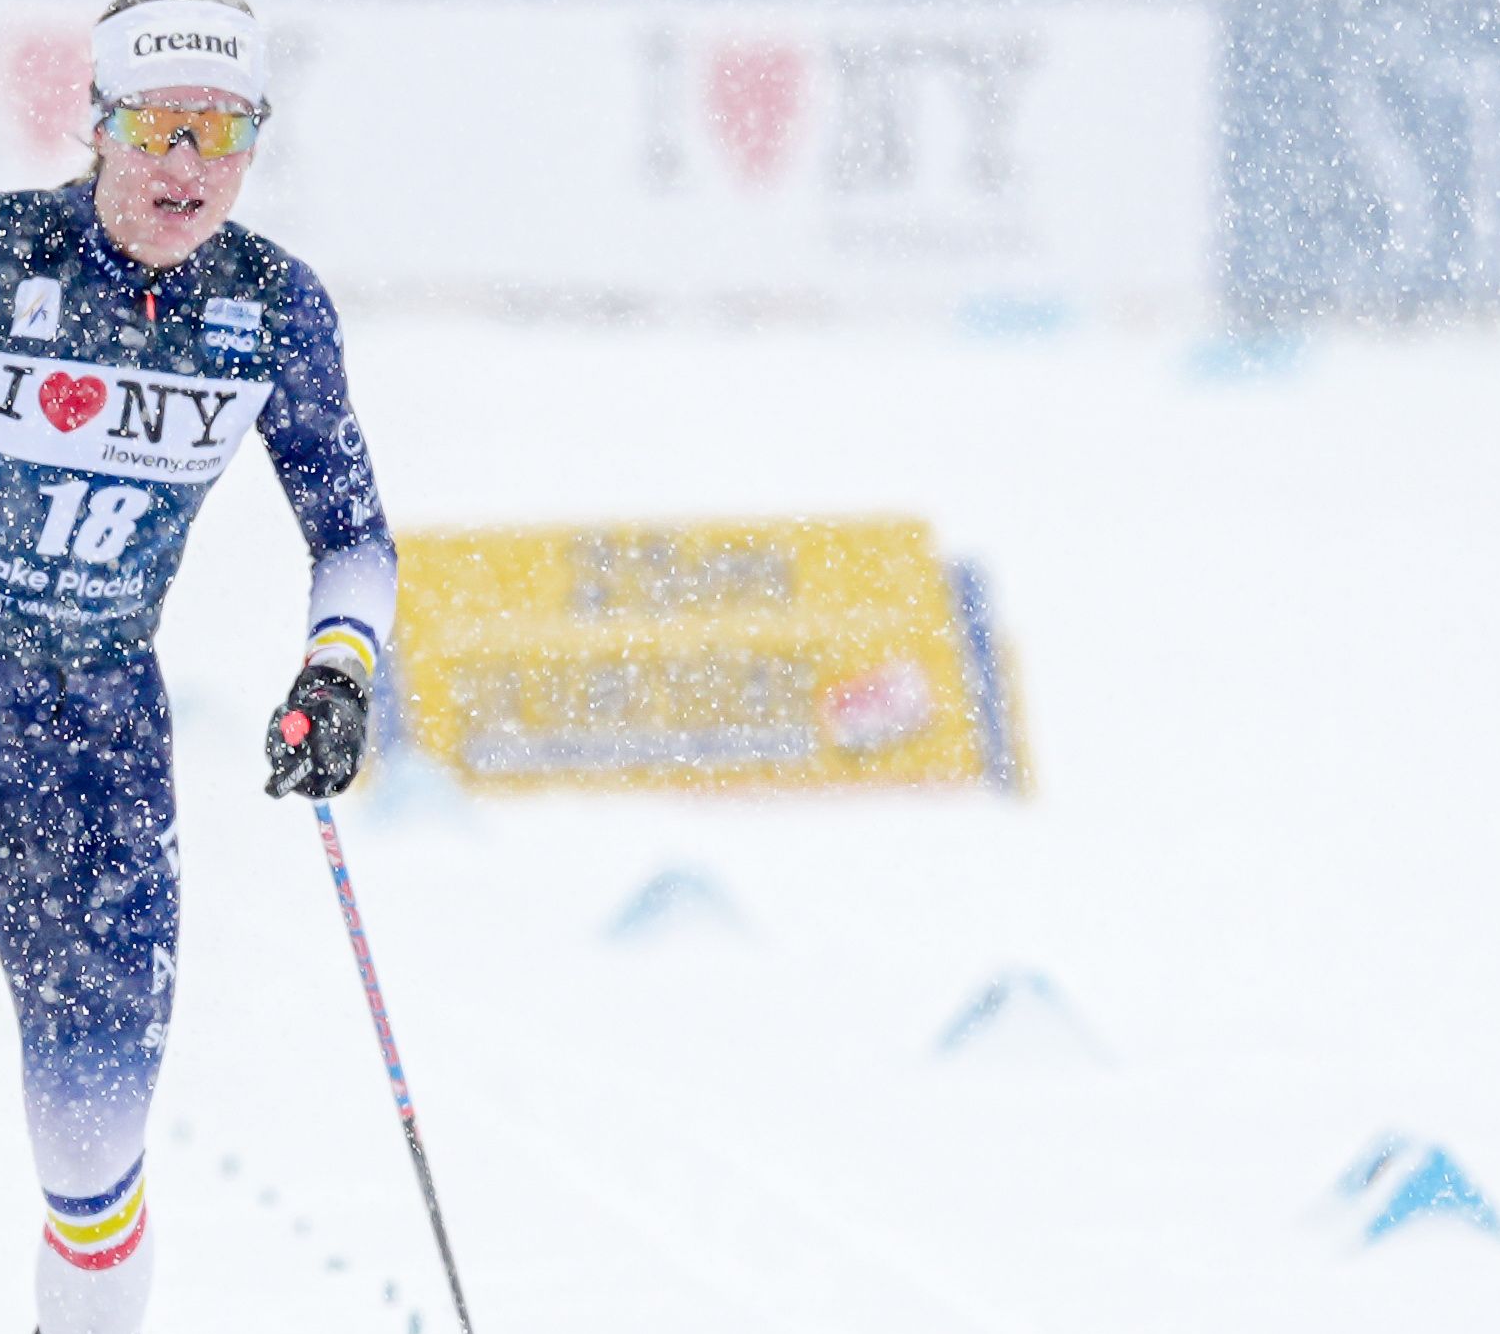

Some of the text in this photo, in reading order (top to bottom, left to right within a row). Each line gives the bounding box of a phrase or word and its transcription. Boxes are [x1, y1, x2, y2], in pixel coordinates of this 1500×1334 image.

[133, 33, 238, 60] Creand
[108, 379, 237, 448] NY
[102, 443, 220, 474] iloveny.com
[35, 480, 151, 563] 18
[53, 569, 144, 598] Placid
